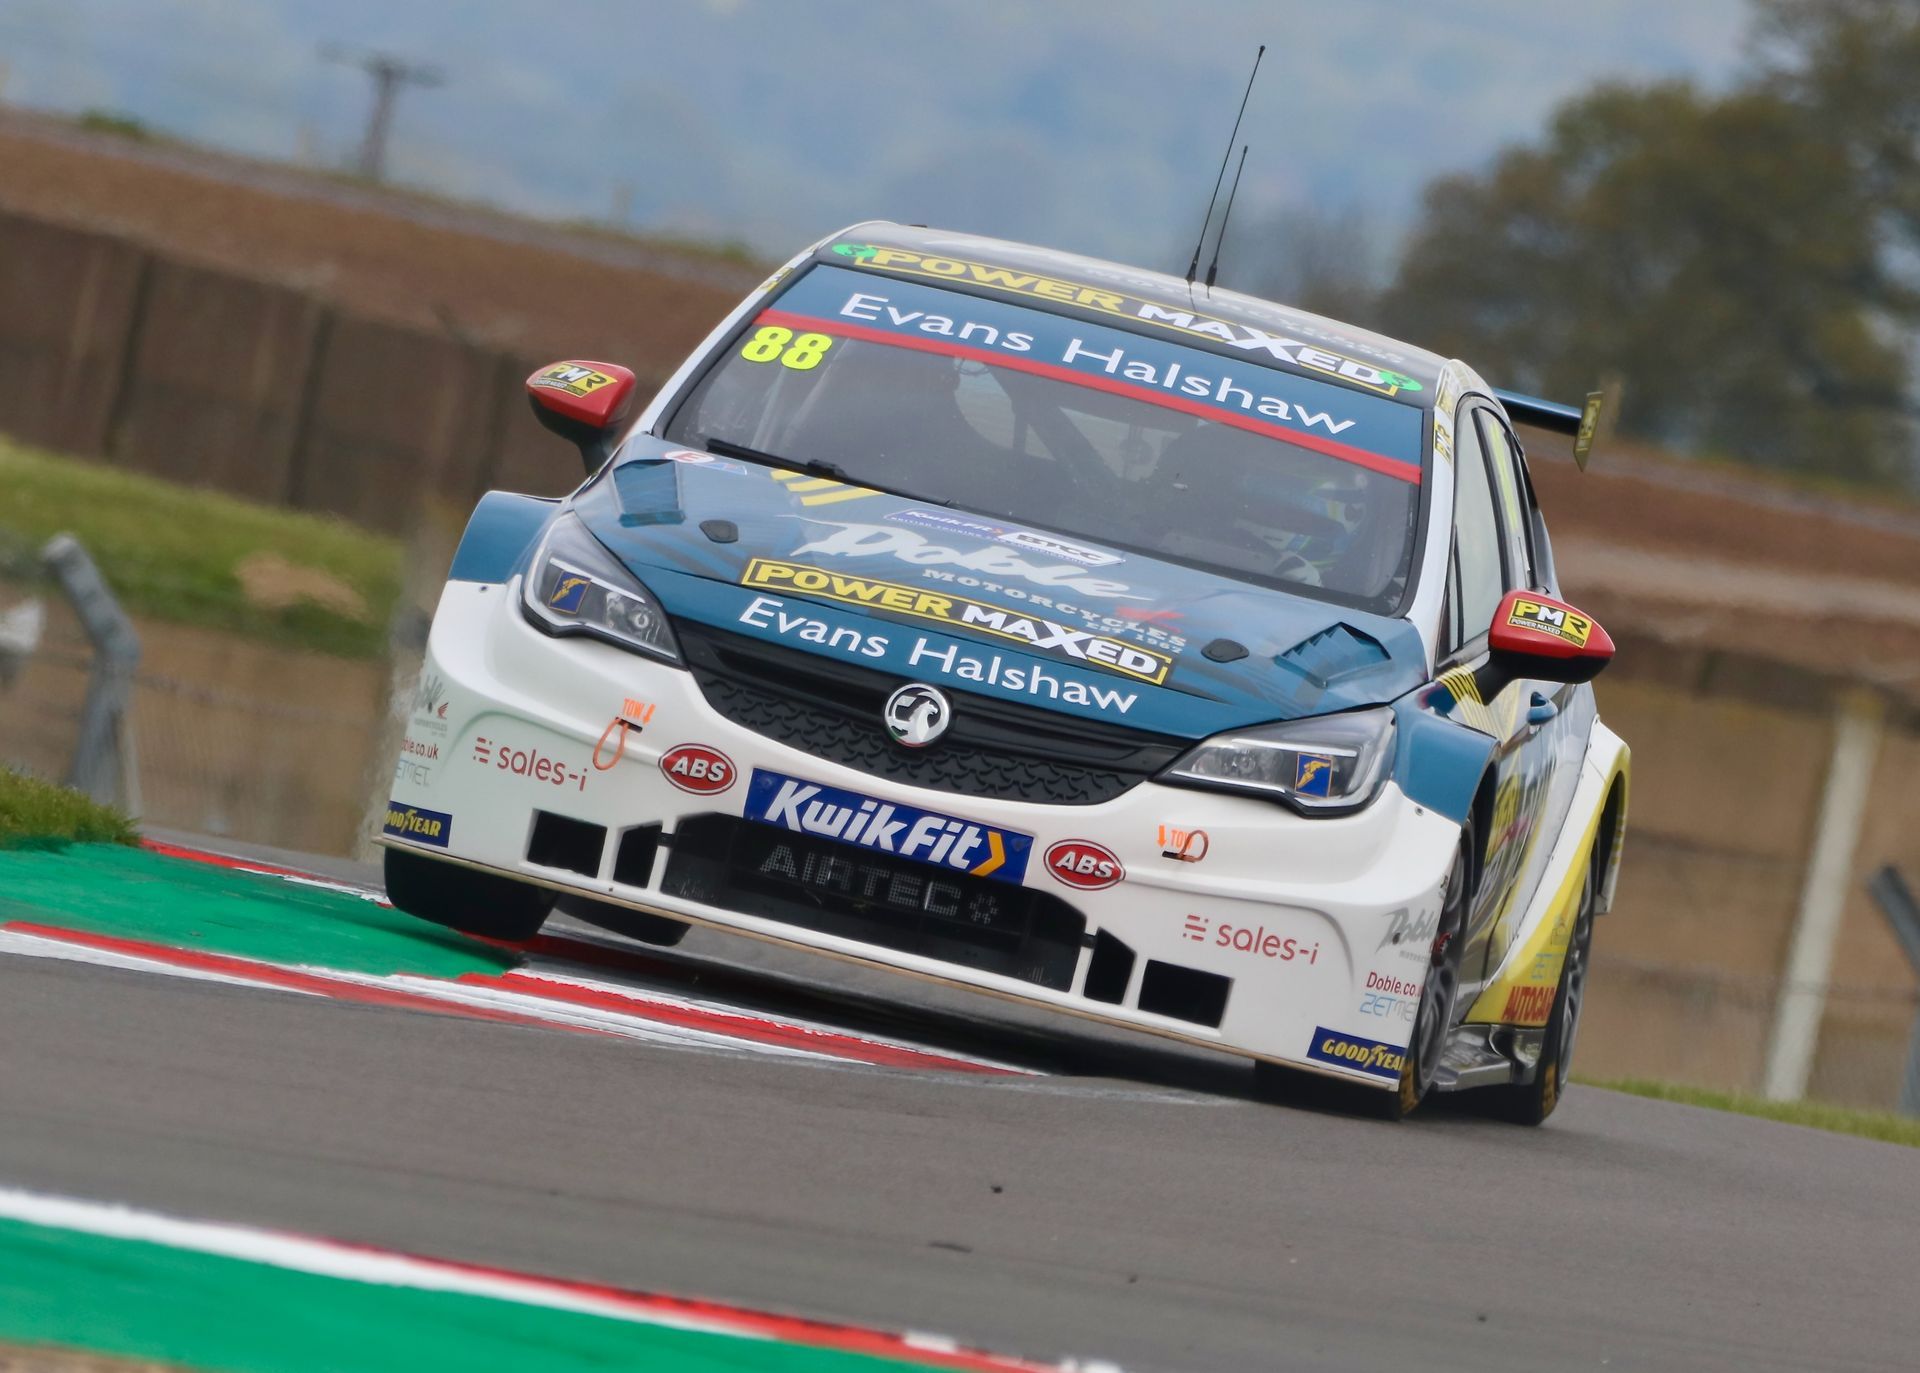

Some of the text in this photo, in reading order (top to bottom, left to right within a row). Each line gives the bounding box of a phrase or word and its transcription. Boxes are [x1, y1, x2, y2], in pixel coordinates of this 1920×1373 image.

[872, 250, 1124, 311] POWER
[1138, 304, 1386, 384] MAXED
[741, 326, 832, 370] 88
[840, 293, 1032, 351] Evans
[1062, 338, 1357, 434] Halshaw
[543, 364, 607, 389] PMR
[774, 514, 1157, 601] Doble
[1017, 534, 1103, 561] BTCC
[754, 566, 1158, 675] POWER MAXED
[922, 568, 1187, 648] MOTORCYCLES
[1511, 618, 1537, 628] POWER
[1537, 623, 1560, 635] MAXED
[1515, 601, 1587, 635] PMR
[739, 598, 1139, 714] Evans Halshaw
[623, 698, 645, 719] TOW
[499, 745, 588, 791] sales-i
[671, 756, 726, 782] ABS
[384, 809, 441, 836] OODYEAR
[760, 845, 961, 917] AIRTEC
[1056, 850, 1115, 880] ABS
[1215, 923, 1320, 964] sales-i
[1366, 971, 1424, 998] Doble.co.
[1322, 1039, 1405, 1071] GOODYEA
